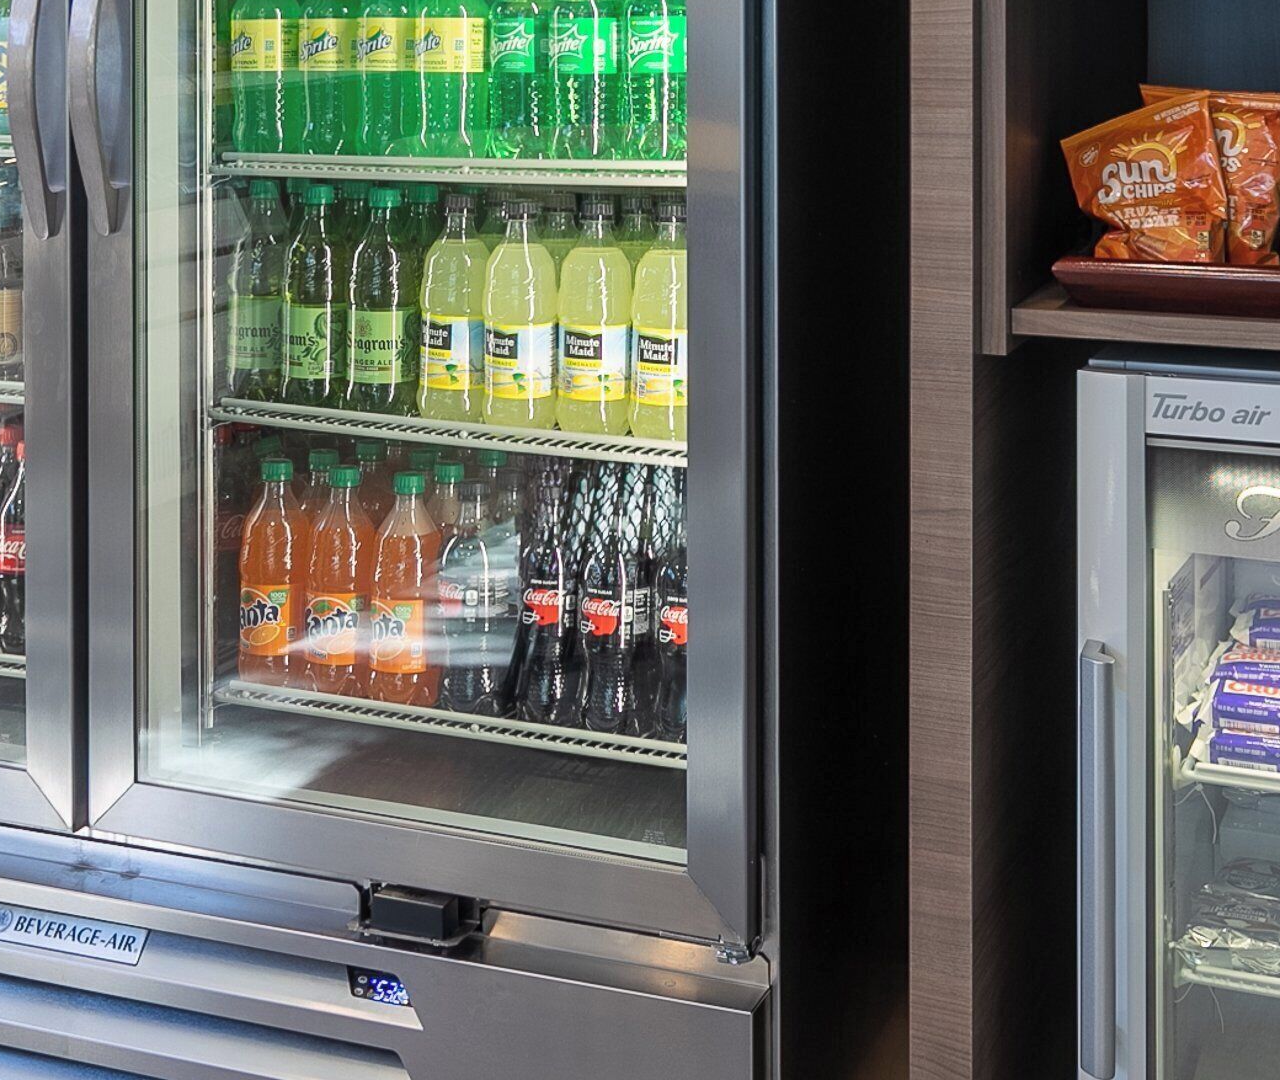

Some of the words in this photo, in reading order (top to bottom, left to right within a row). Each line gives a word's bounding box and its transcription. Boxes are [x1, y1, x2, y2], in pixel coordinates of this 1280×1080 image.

[300, 31, 337, 63] Sprite
[357, 31, 392, 64] Sprite
[491, 36, 527, 55] Sprite
[629, 36, 671, 55] Sprite
[1097, 158, 1177, 205] Sun
[1122, 182, 1177, 200] CHIPS
[566, 334, 600, 349] Minute
[569, 344, 595, 357] Maid
[640, 340, 675, 353] Minute
[643, 351, 670, 362] Maid
[1151, 394, 1225, 424] Turbo
[1231, 405, 1272, 427] air
[582, 596, 620, 617] Coca-Cola
[13, 915, 136, 953] BEVERAGE-AIR
